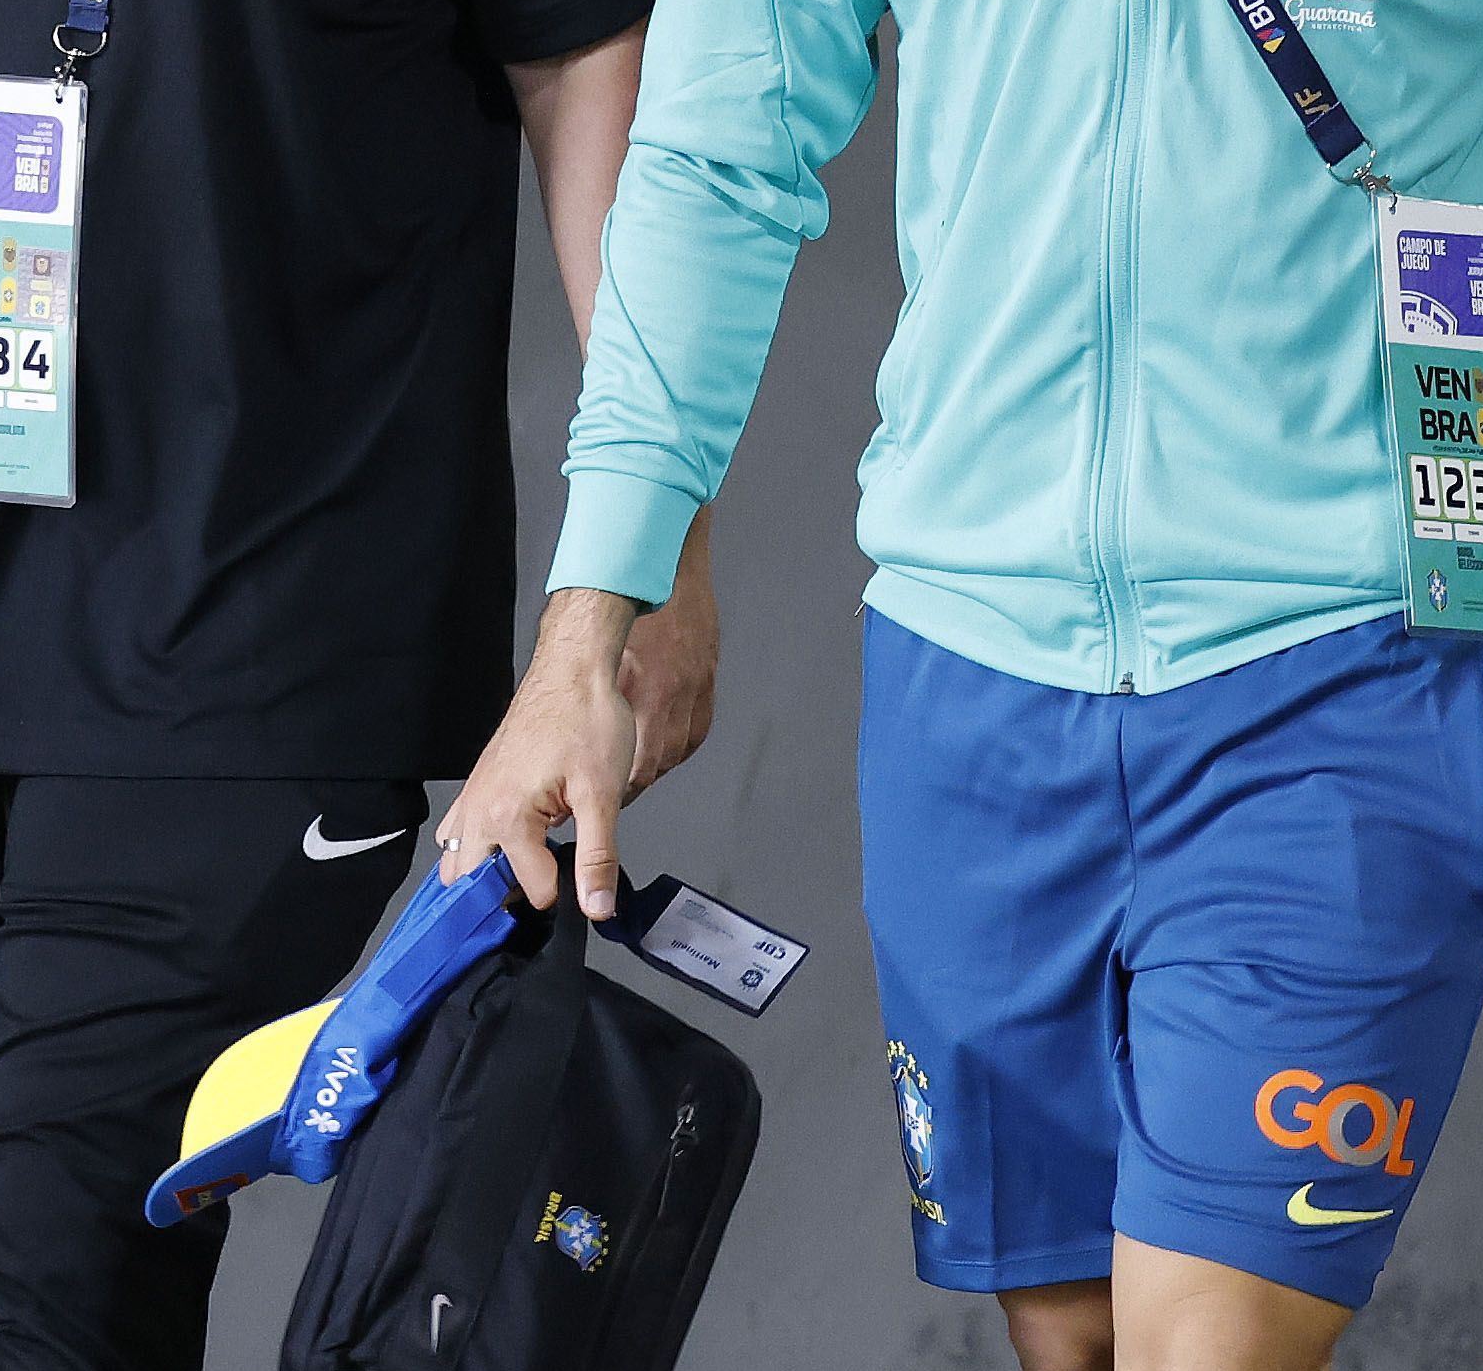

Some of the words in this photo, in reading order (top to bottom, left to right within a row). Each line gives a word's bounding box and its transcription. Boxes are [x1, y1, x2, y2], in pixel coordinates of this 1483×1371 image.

[1399, 236, 1433, 255] CAMPO
[1433, 239, 1447, 256] DE
[1401, 254, 1430, 271] JUEGO
[1414, 364, 1472, 402] VEN
[1418, 408, 1478, 445] BRA
[752, 940, 787, 960] CBF
[316, 1047, 359, 1107] vivo
[1253, 1068, 1416, 1177] GOL
[533, 1190, 563, 1243] BRASIL
